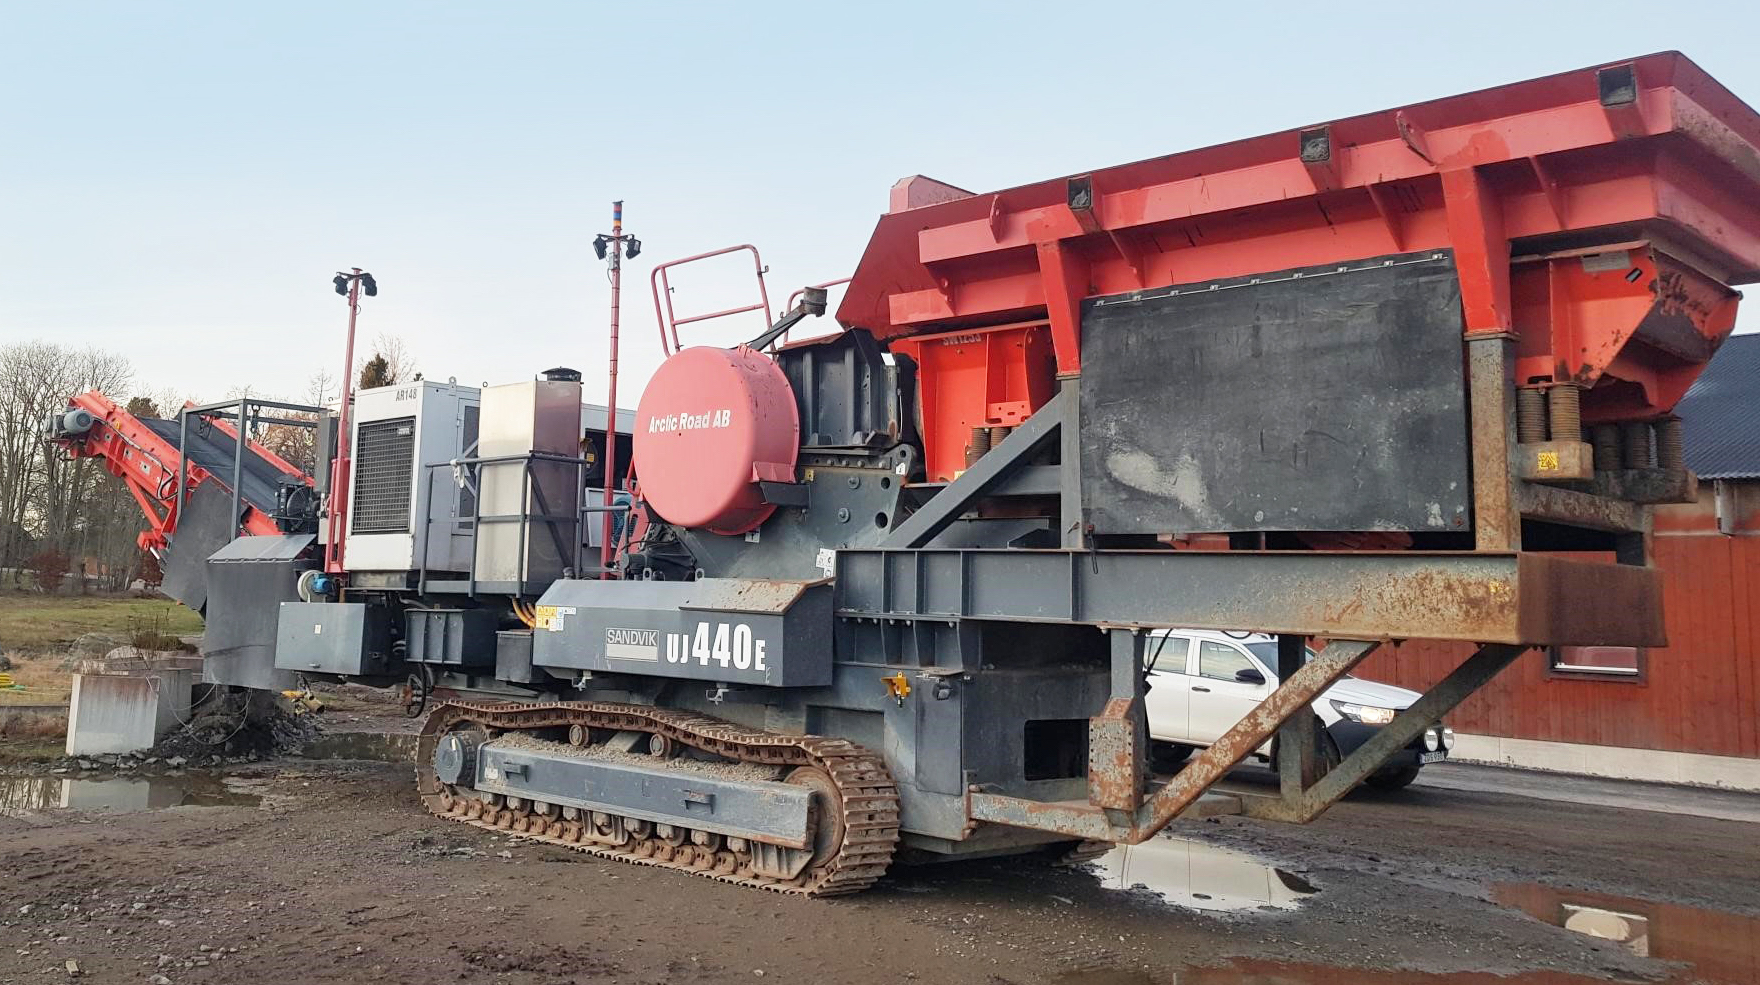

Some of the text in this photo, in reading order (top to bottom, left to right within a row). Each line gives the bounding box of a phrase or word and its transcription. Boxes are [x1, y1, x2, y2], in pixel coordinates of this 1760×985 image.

[396, 389, 417, 401] AR148
[648, 409, 731, 433] Arctic Road AB
[607, 629, 657, 647] SANDVIK
